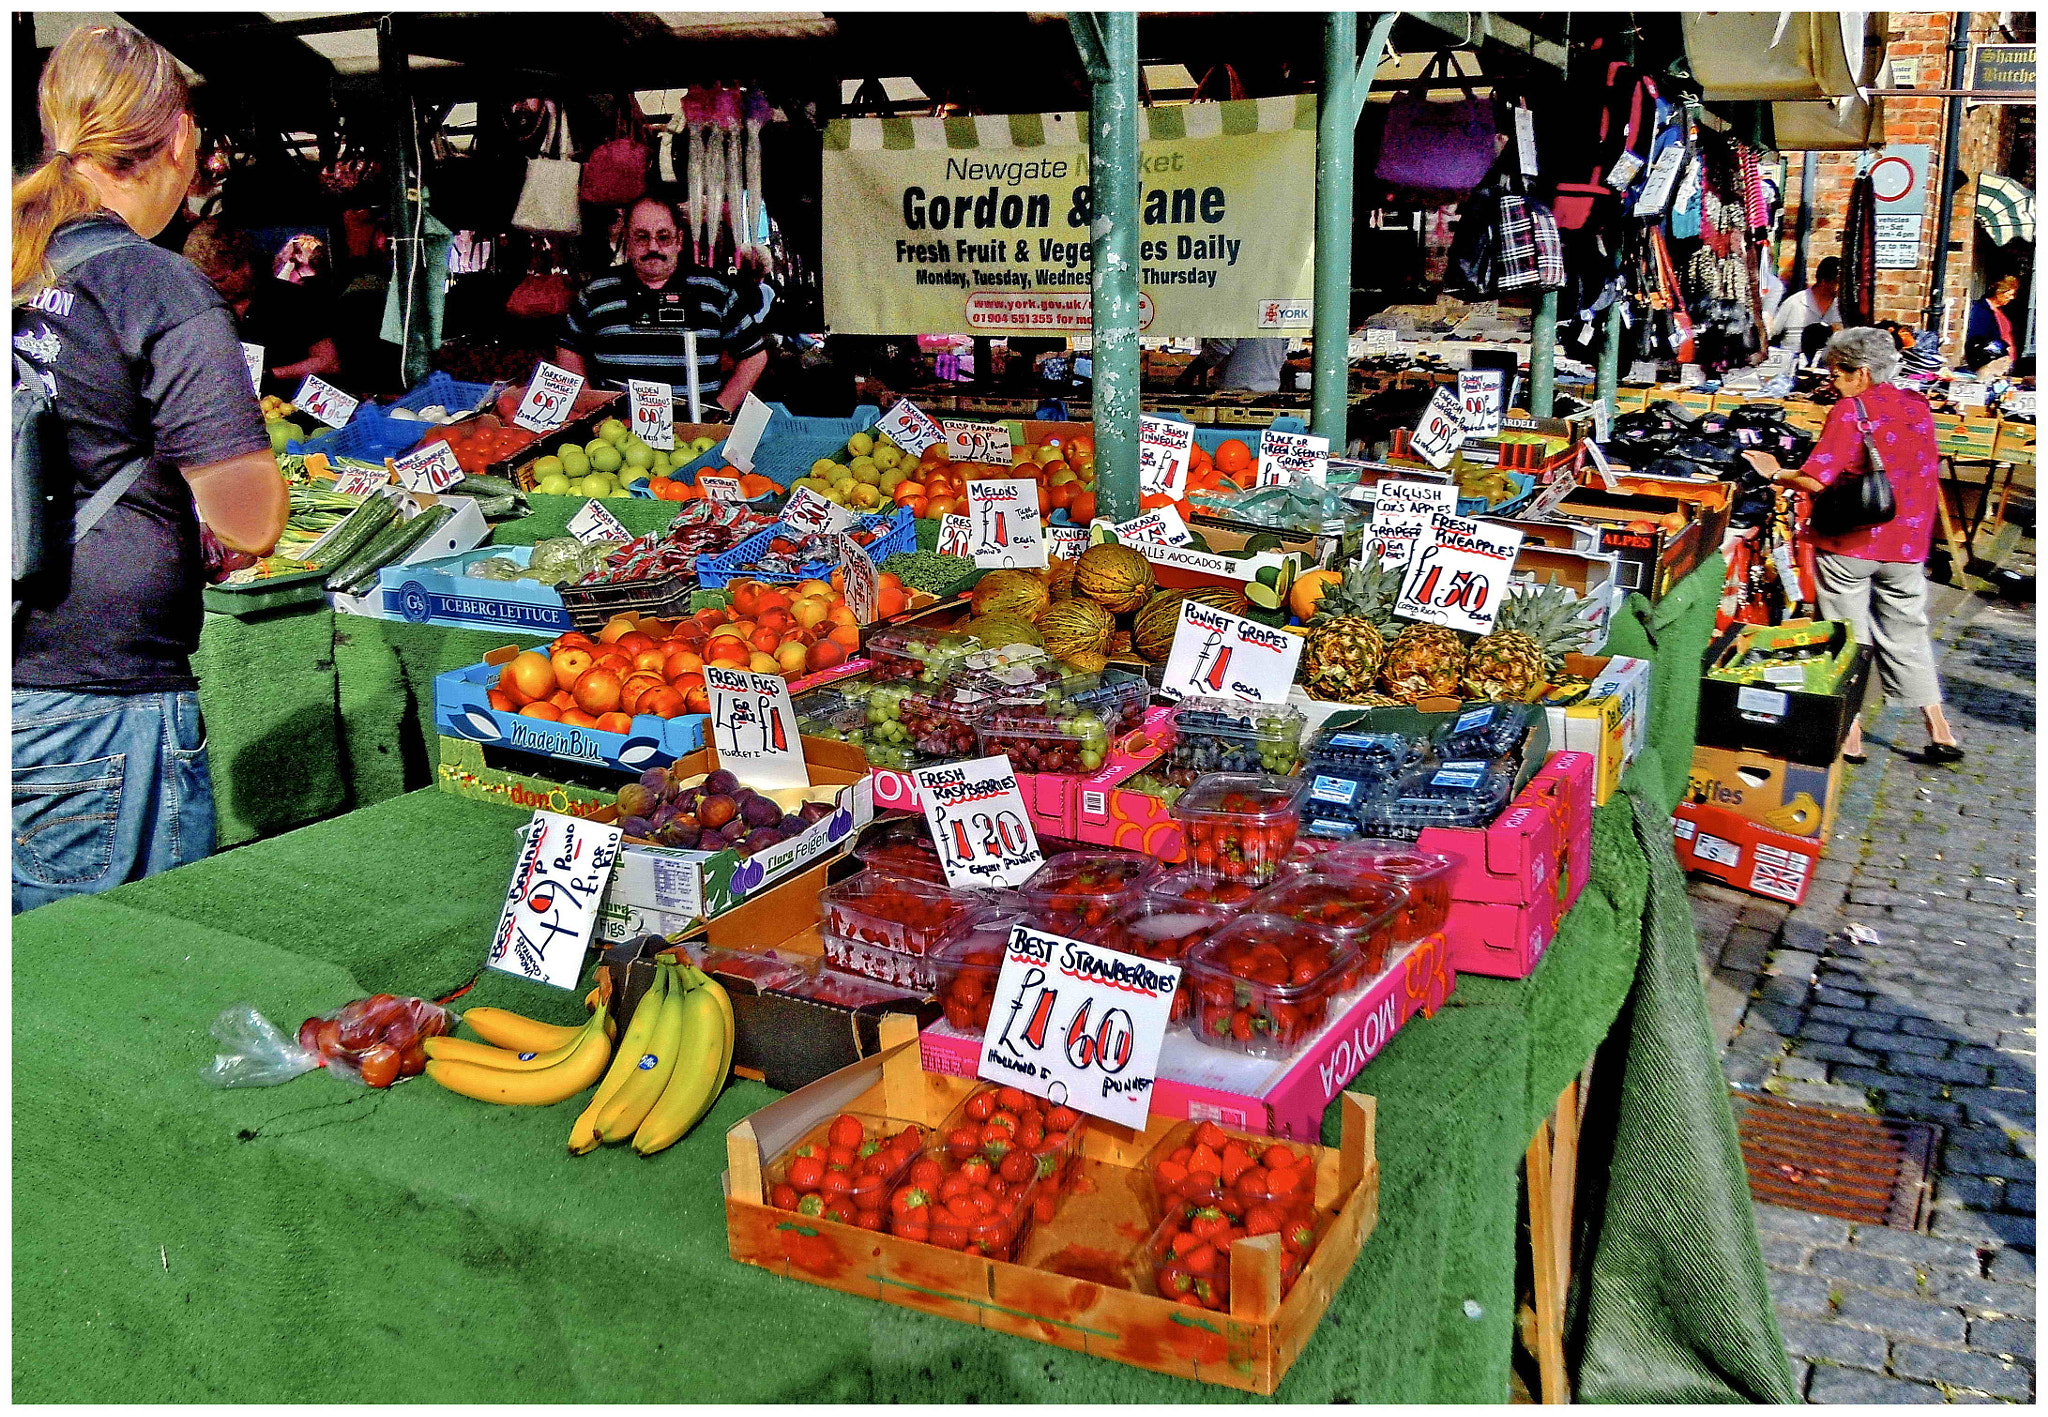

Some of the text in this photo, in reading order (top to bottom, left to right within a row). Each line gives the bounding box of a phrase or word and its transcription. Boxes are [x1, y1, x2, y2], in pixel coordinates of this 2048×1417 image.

[946, 158, 1068, 186] Newgate
[903, 181, 1226, 230] Gordon & ane
[896, 239, 951, 263] Fresh
[956, 239, 1007, 263] Fruit
[1014, 239, 1030, 263] &
[1177, 234, 1241, 266] Daily
[916, 267, 1218, 289] Monday, Tuesday, Thursday
[972, 314, 1009, 325] 01904
[1056, 314, 1073, 324] for
[1279, 309, 1309, 319] YORK
[541, 365, 580, 387] YORKSHIRE
[544, 378, 574, 394] TOMATOES
[633, 382, 660, 395] GOLDEN
[945, 421, 969, 431] CRISP
[1261, 443, 1289, 455] GREEN
[1265, 432, 1294, 445] BLACK
[1277, 456, 1315, 468] GRAPES
[971, 483, 1018, 498] MELONS
[1382, 483, 1442, 501] ENGLISH
[1431, 513, 1478, 534] FRESH
[940, 525, 968, 557] 20
[1435, 529, 1515, 558] PINEAPPLES
[1602, 533, 1652, 548] ALPES
[1167, 552, 1222, 570] AVOCADOS
[441, 597, 561, 624] ICEBERG LETTUCE
[1184, 602, 1288, 649] PUNNET GRAPES
[707, 667, 780, 698] FRESH FIGS
[511, 719, 556, 751] Made
[569, 729, 604, 761] Blu
[918, 768, 966, 788] FRESH
[1090, 764, 1127, 784] MOYCA
[933, 776, 1016, 801] RASPBERRIES
[767, 832, 828, 869] flora Feigen
[490, 817, 545, 963] BEST BANANAS
[1008, 929, 1175, 994] BEST STRAWBERRIES
[1319, 992, 1395, 1097] MOYCA
[988, 1048, 1036, 1077] HOLLAND
[1102, 1075, 1153, 1098] PUNNET
